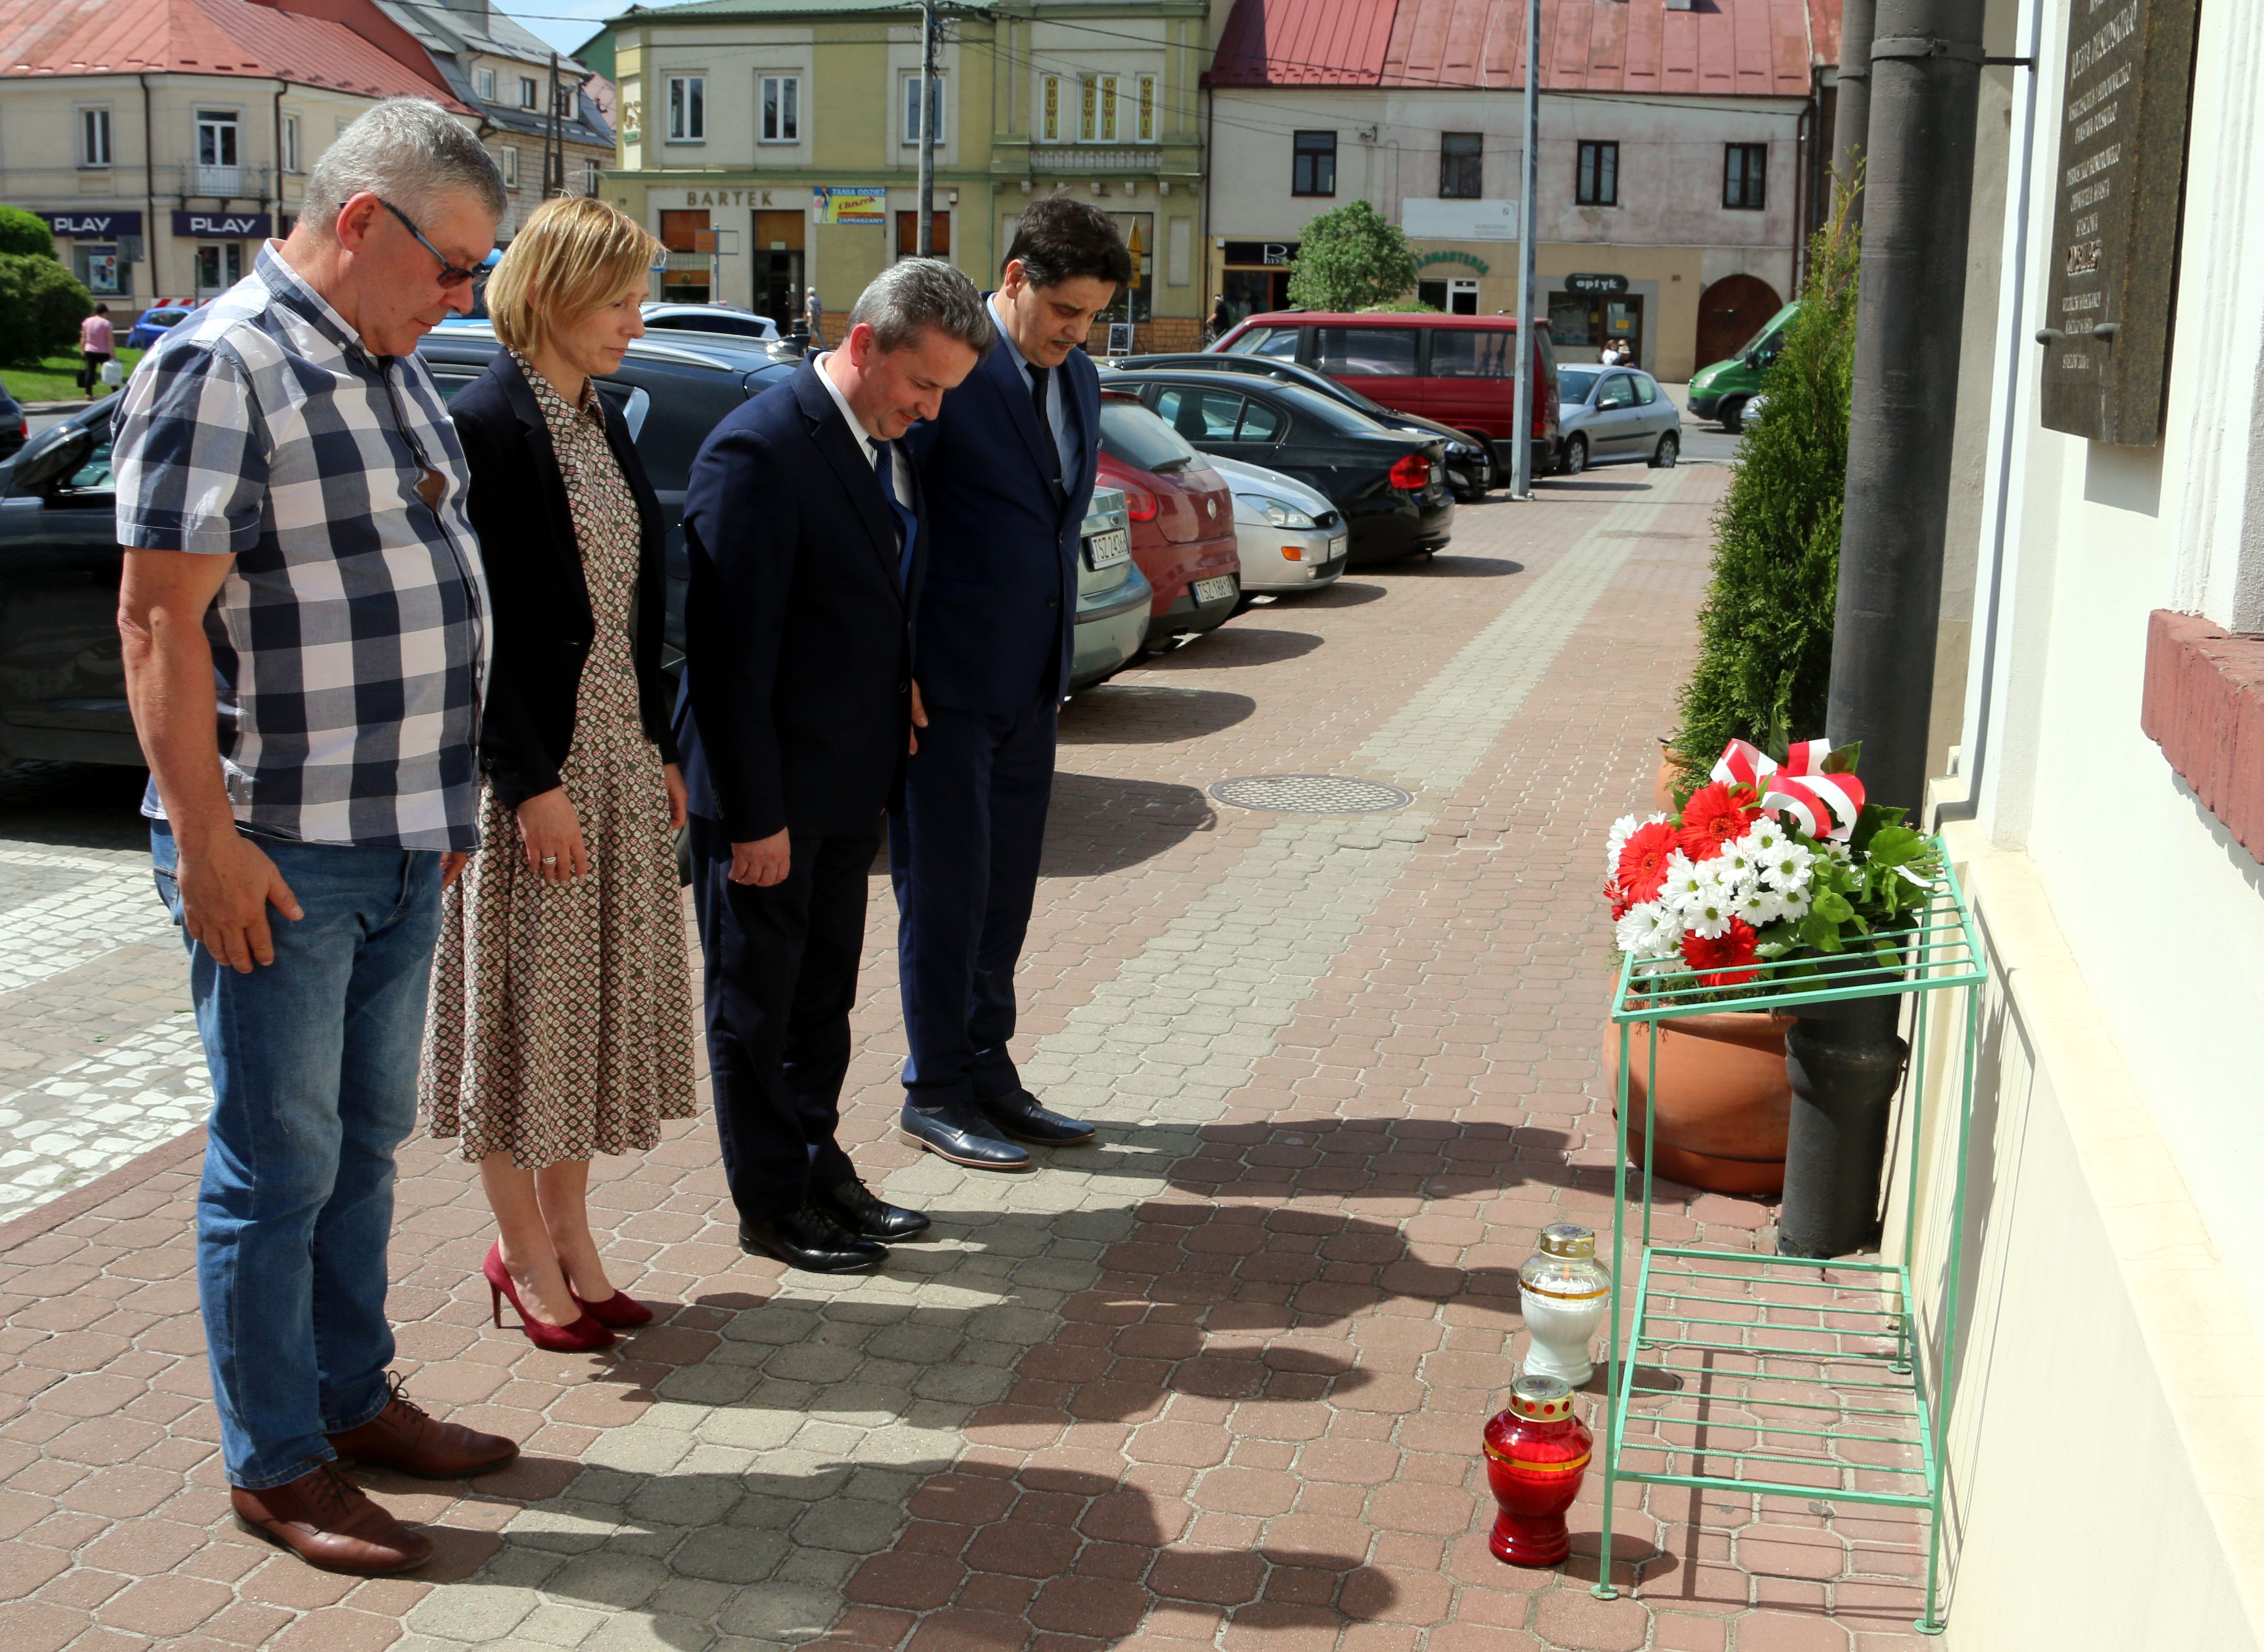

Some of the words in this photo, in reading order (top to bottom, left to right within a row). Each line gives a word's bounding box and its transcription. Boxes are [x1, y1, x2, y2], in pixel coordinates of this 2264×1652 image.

[1046, 79, 1056, 138] OBUWIE
[1084, 79, 1094, 138] OBUWIE
[1104, 79, 1115, 138] OBUWIE
[1141, 79, 1151, 138] OBUWIE
[687, 191, 772, 206] BARTEK
[858, 187, 886, 196] ODZIEŻ
[54, 217, 111, 232] PLAY
[191, 218, 256, 233] PLAY
[1576, 279, 1617, 291] optyk
[1093, 537, 1109, 560] TSZ
[1197, 581, 1215, 601] TSZ
